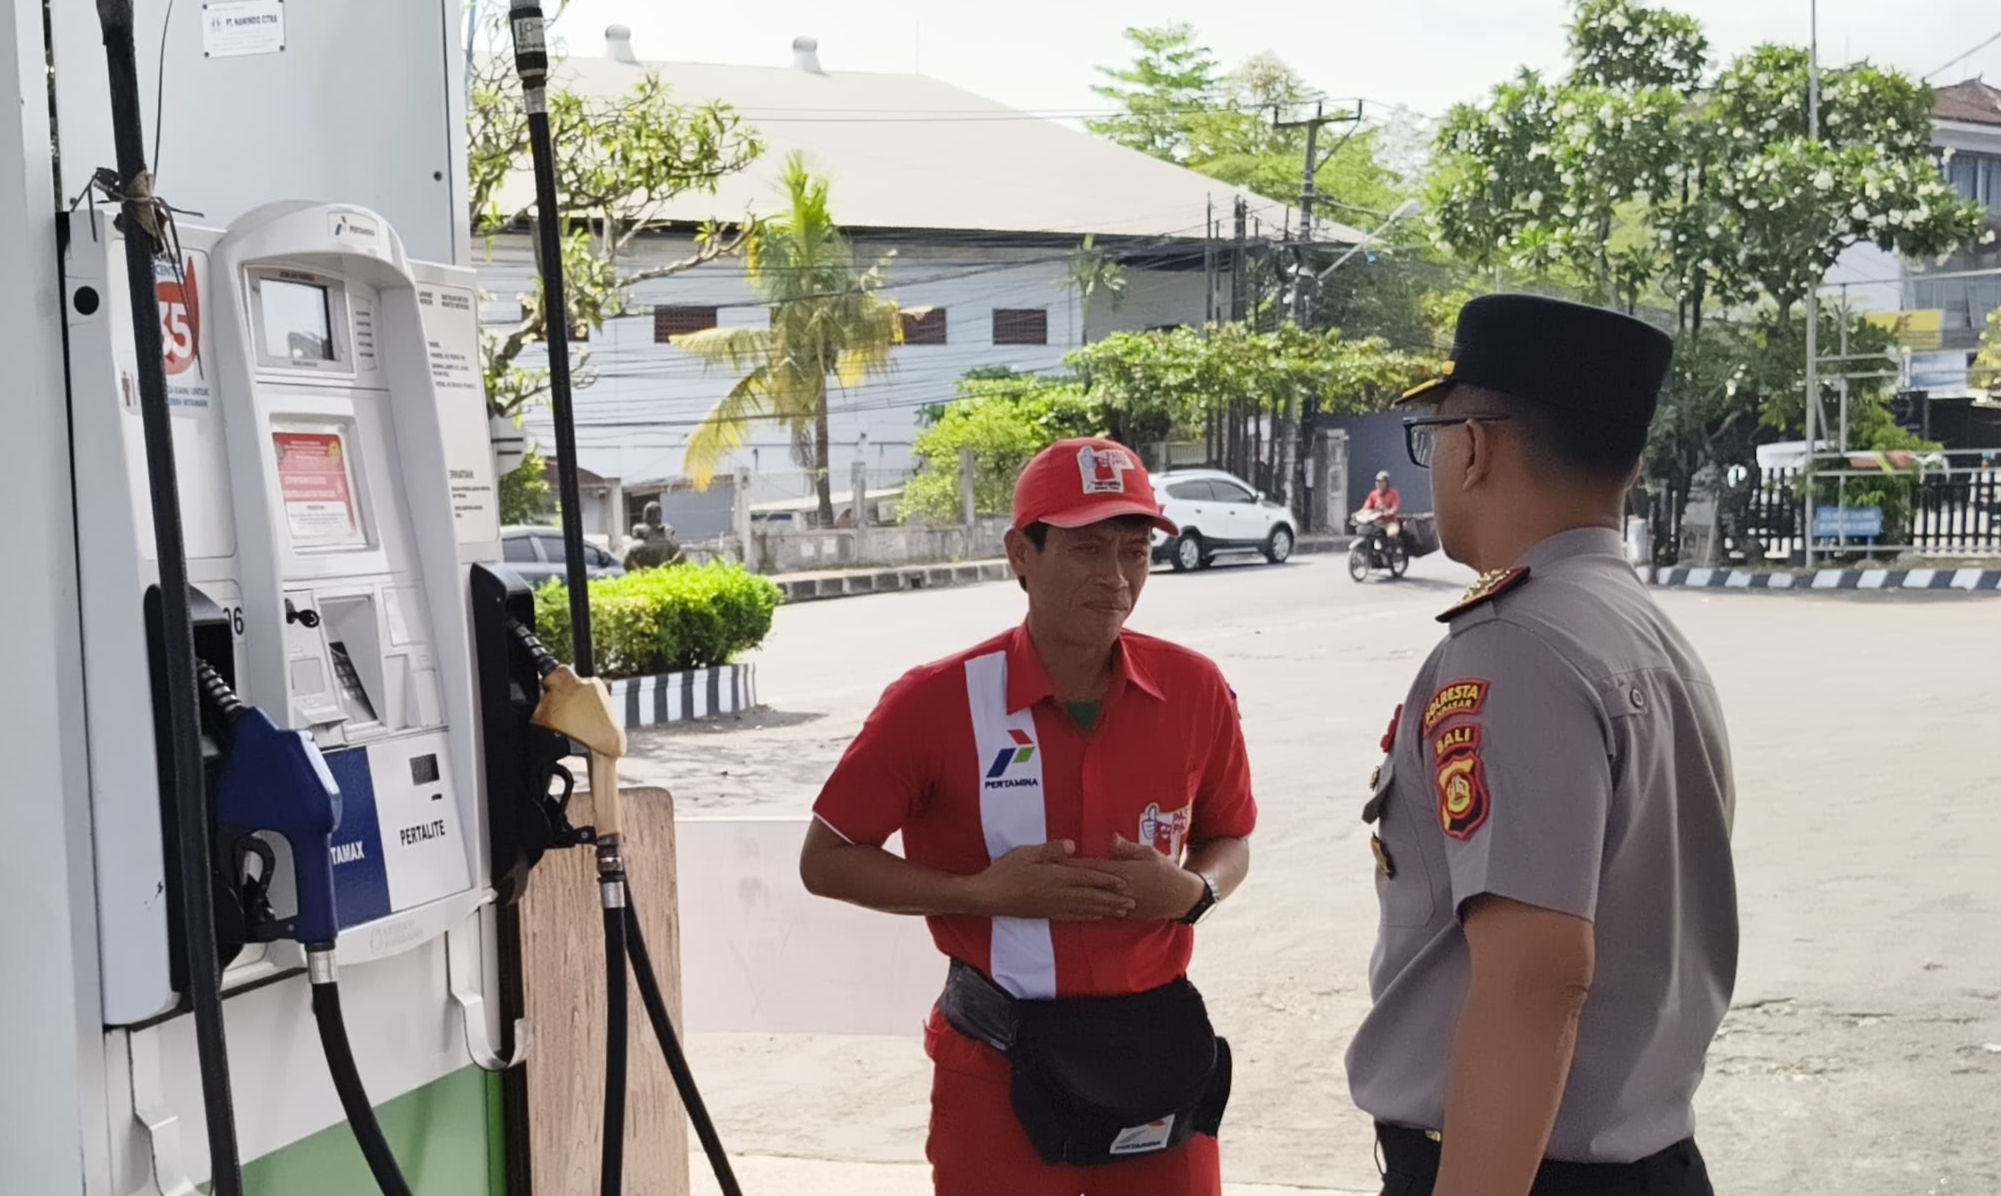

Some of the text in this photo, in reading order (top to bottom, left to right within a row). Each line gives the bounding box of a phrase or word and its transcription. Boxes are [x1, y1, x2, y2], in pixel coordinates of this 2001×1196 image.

[1425, 684, 1479, 725] POLRESTA
[1436, 727, 1471, 754] BALI
[984, 778, 1039, 789] PERTAMINA
[400, 820, 446, 846] PERTALITE
